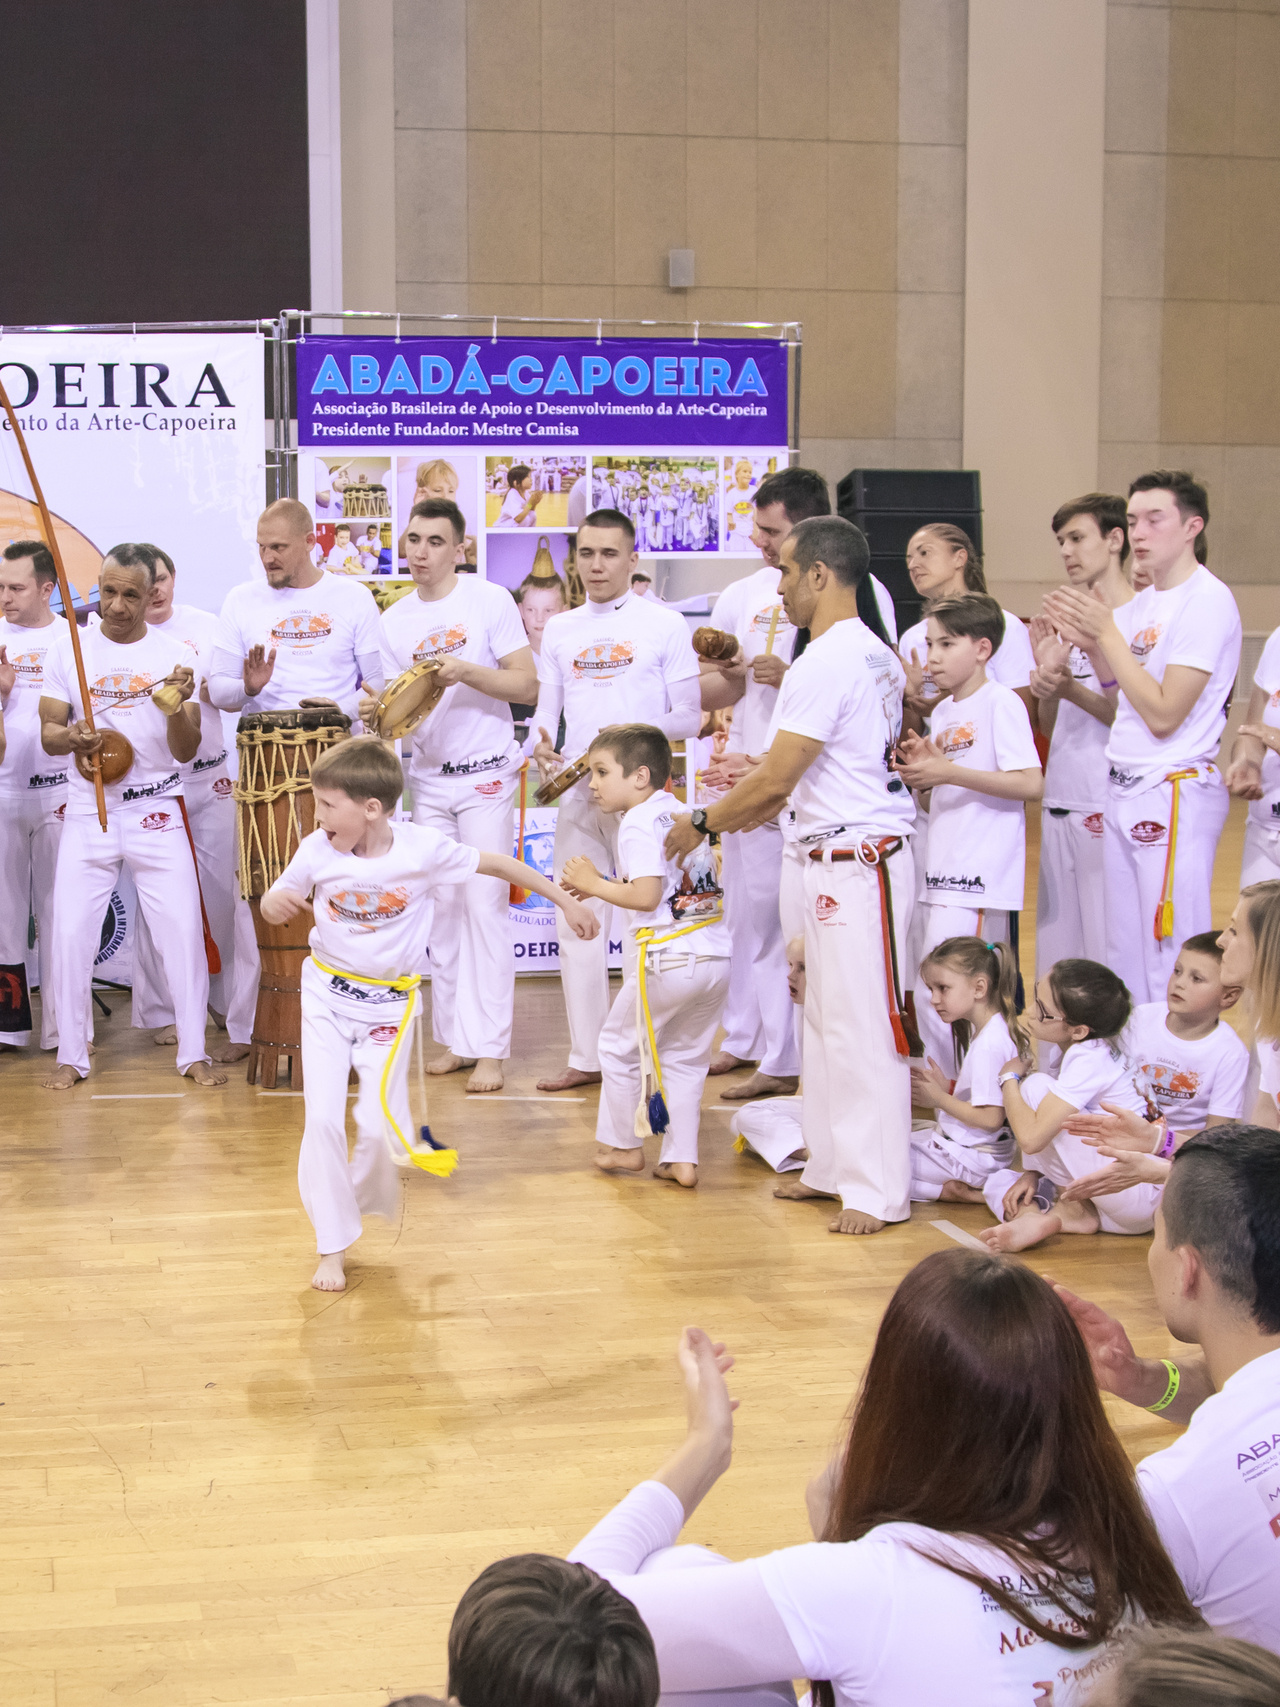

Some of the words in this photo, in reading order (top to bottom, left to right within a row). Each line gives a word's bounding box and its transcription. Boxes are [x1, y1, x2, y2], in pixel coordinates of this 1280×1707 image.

[311, 343, 769, 397] ABADÁ-CAPOEIRA
[312, 401, 388, 418] Associação
[391, 401, 460, 415] Brasileira
[462, 401, 477, 415] de
[479, 401, 522, 418] Apoio
[525, 405, 533, 415] e
[536, 401, 654, 416] Desenvolvimento
[656, 402, 673, 416] da
[676, 402, 768, 419] Arte-Capoeira
[55, 411, 80, 431] da
[87, 411, 237, 436] Arte-Capoeira
[312, 422, 390, 437] Presidente
[394, 422, 469, 437] Fundador:
[472, 422, 523, 437] Mestre
[526, 421, 579, 437] Camisa
[509, 912, 556, 926] RADUADO
[93, 917, 127, 966] INTERNACIONA
